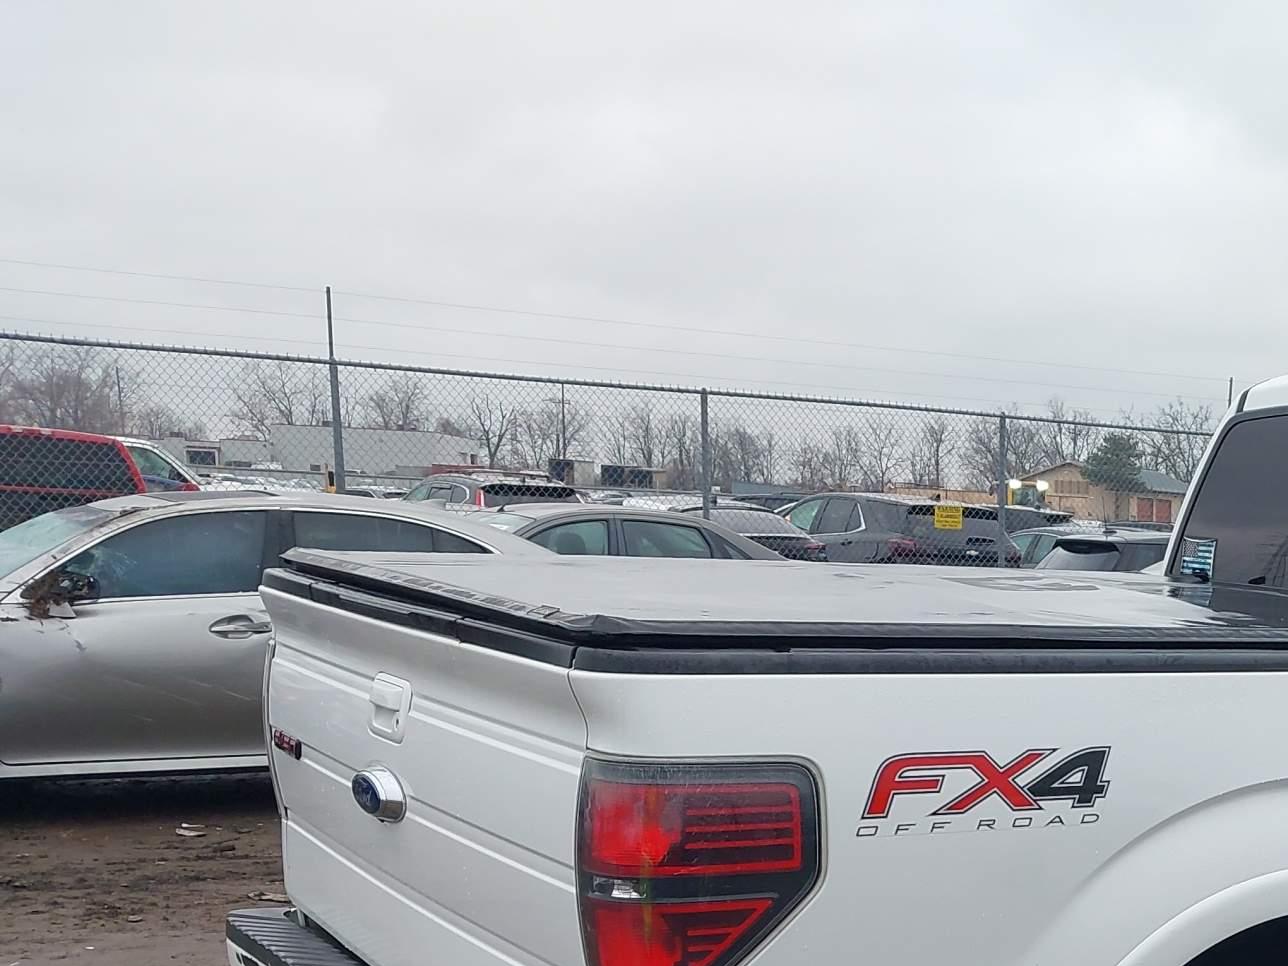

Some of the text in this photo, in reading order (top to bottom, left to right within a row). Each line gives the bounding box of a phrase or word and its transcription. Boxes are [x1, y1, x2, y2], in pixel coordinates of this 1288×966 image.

[861, 745, 1112, 820] FX4
[855, 813, 1101, 838] OFF ROAD
